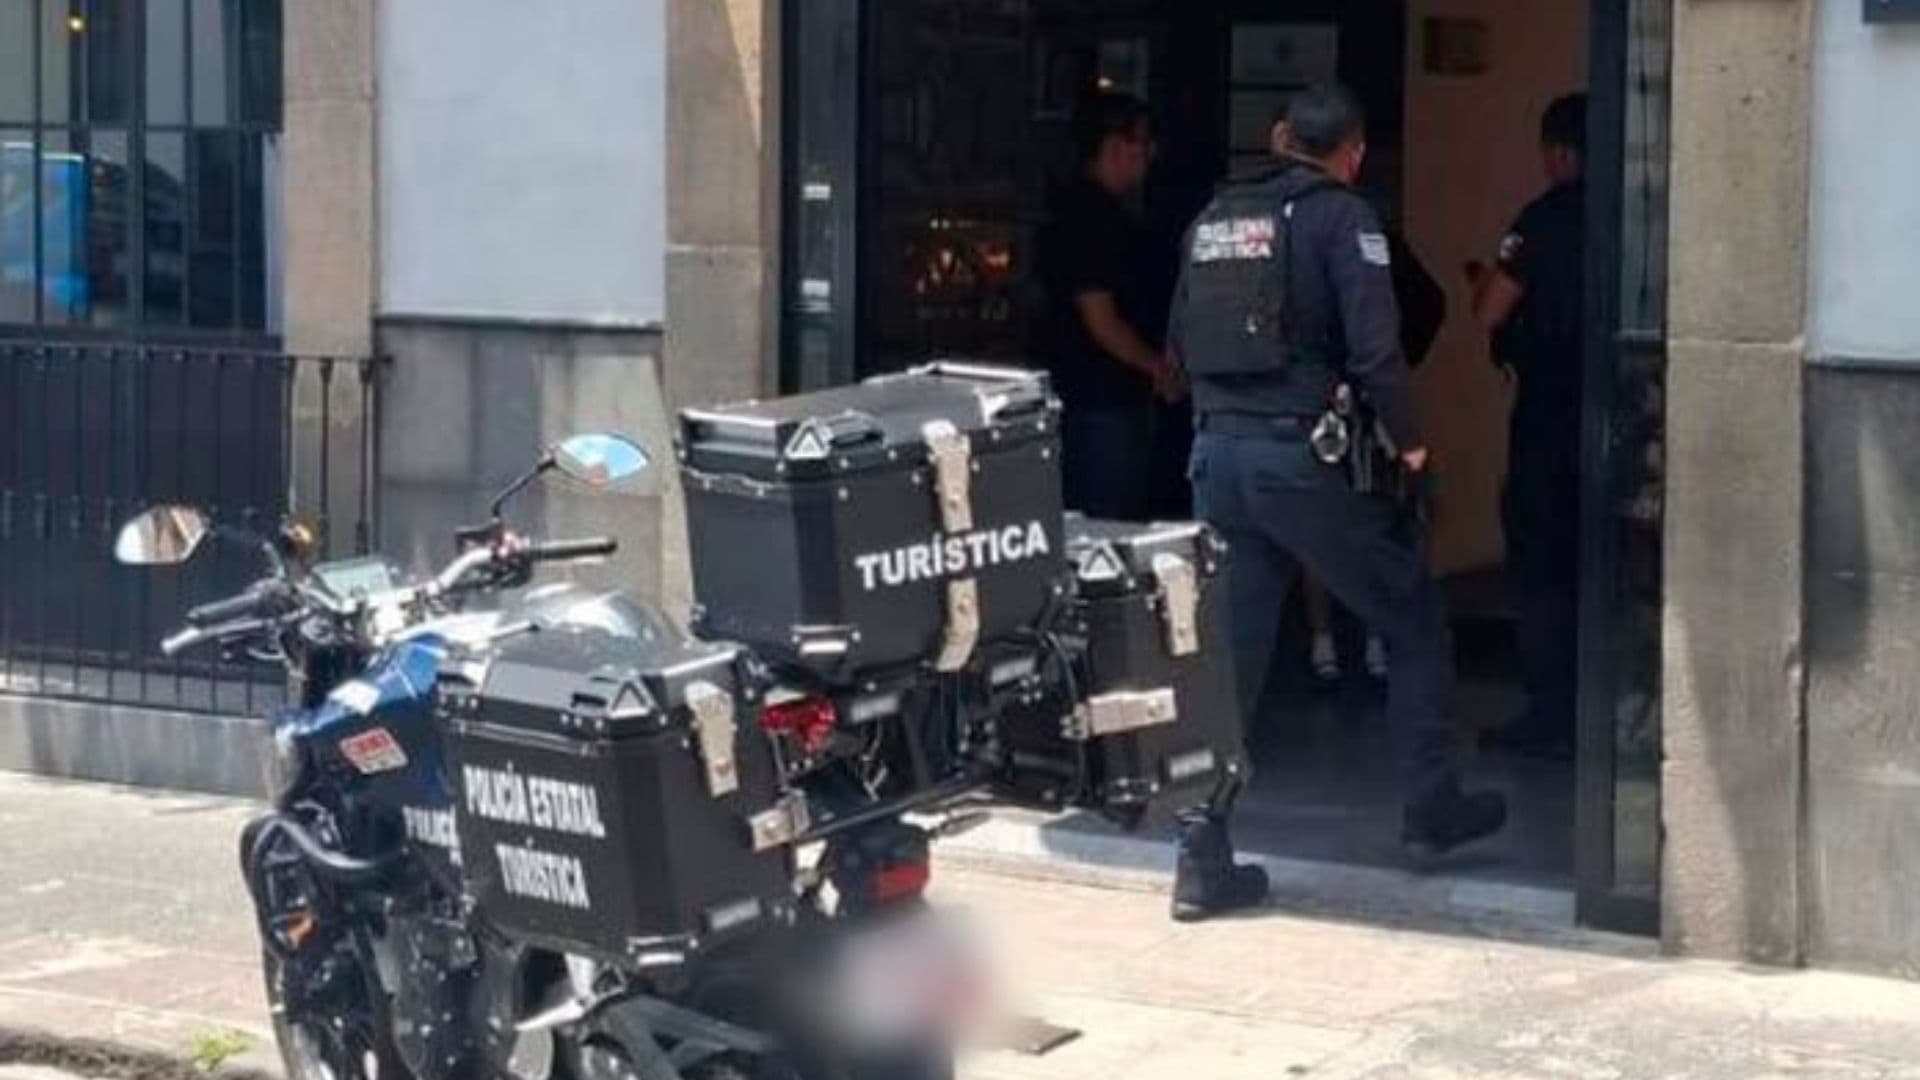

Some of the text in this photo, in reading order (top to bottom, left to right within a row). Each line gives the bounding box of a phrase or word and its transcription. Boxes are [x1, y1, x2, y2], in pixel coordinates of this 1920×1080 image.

[854, 520, 1049, 590] TURÍSTICA
[463, 761, 606, 839] POLICÍA ESTATAL
[494, 837, 591, 910] TURÍSTICA
